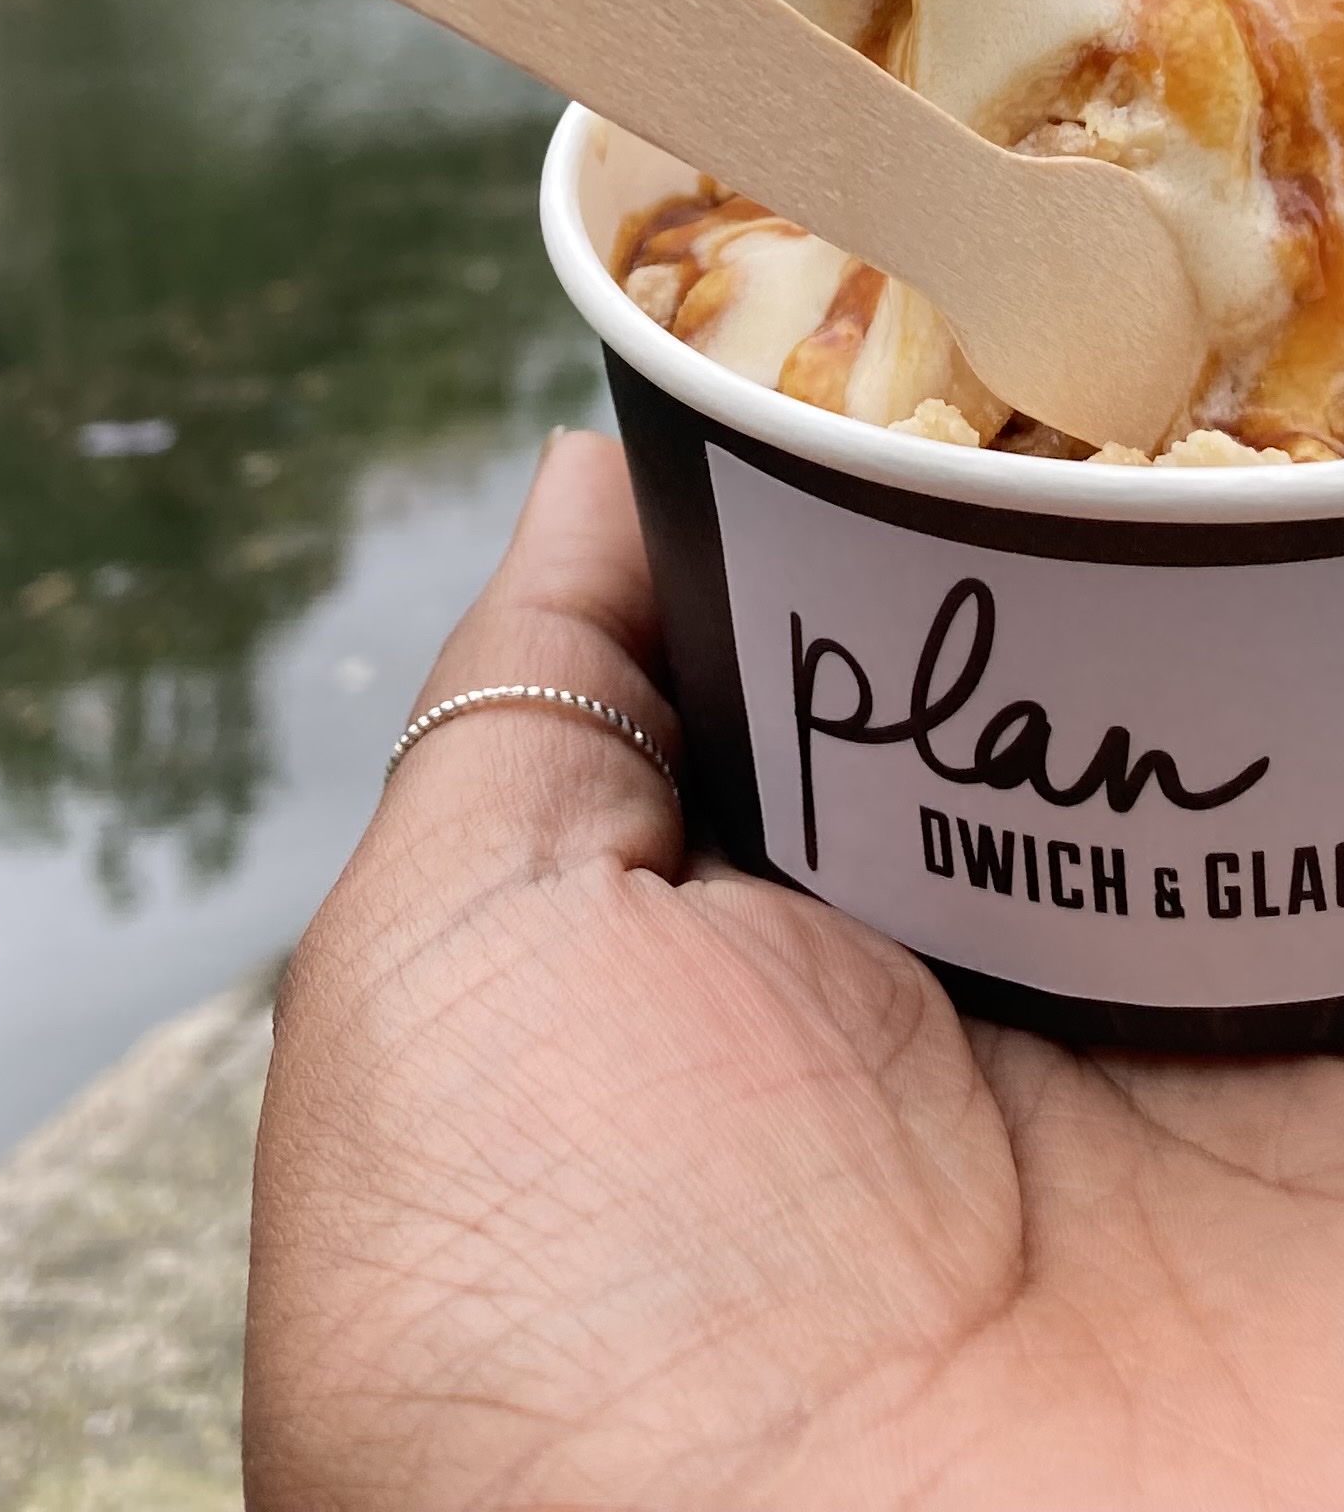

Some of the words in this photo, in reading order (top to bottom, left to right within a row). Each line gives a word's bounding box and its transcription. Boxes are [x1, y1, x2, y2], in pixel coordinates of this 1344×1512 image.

[790, 576, 1272, 871] plan
[919, 804, 1129, 917] DWICH
[1153, 866, 1186, 920] &
